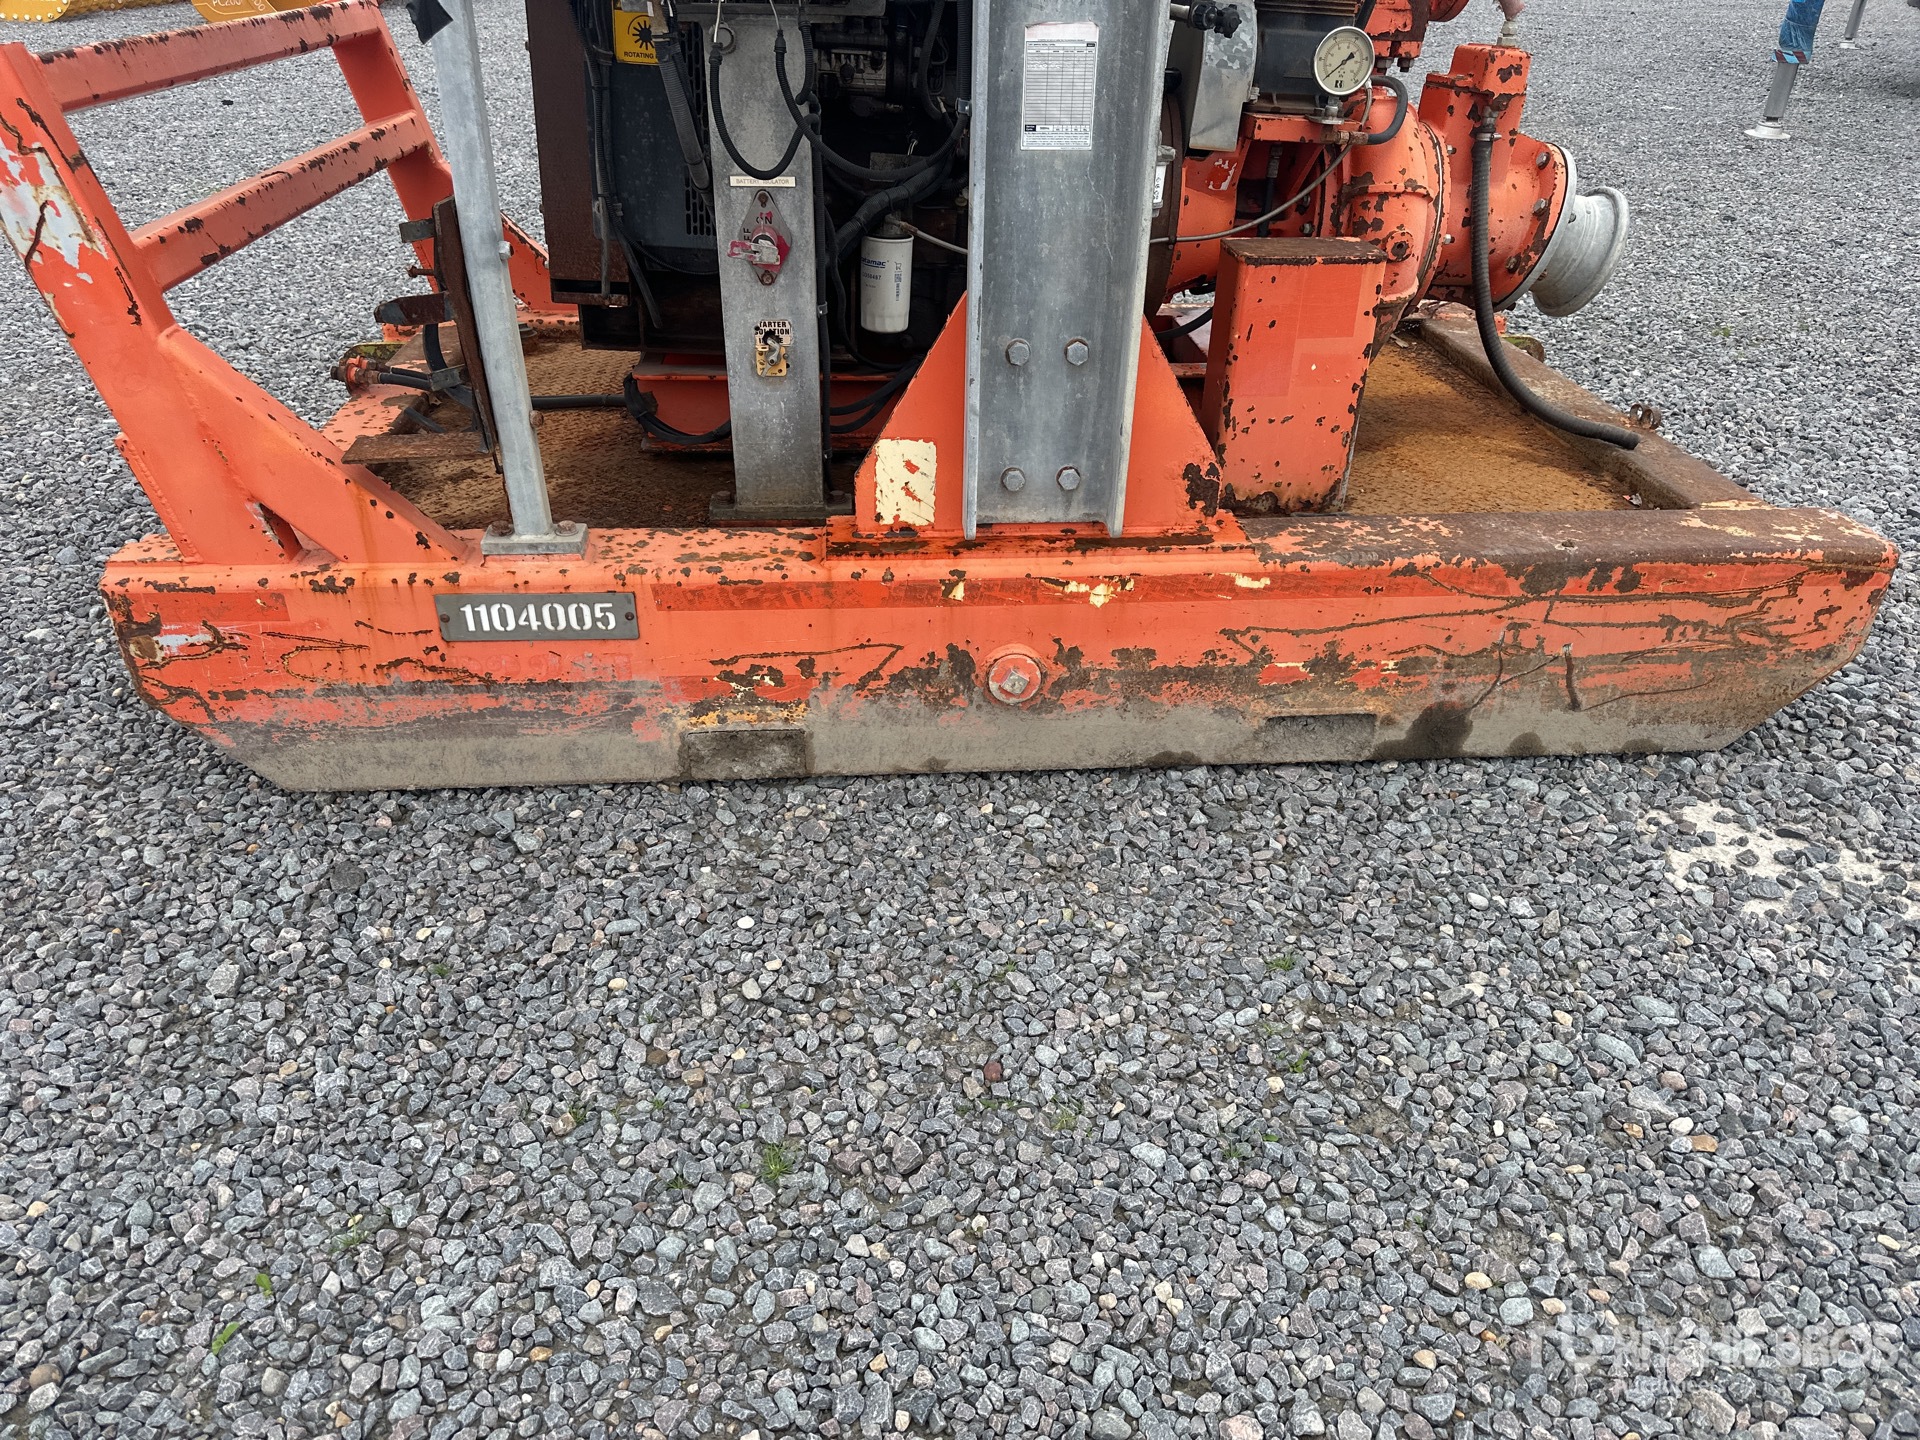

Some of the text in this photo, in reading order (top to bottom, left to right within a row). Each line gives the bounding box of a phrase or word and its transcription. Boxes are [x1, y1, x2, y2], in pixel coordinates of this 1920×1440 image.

[624, 51, 654, 59] ROTATING
[743, 227, 752, 241] FF
[460, 602, 617, 632] 1104005
